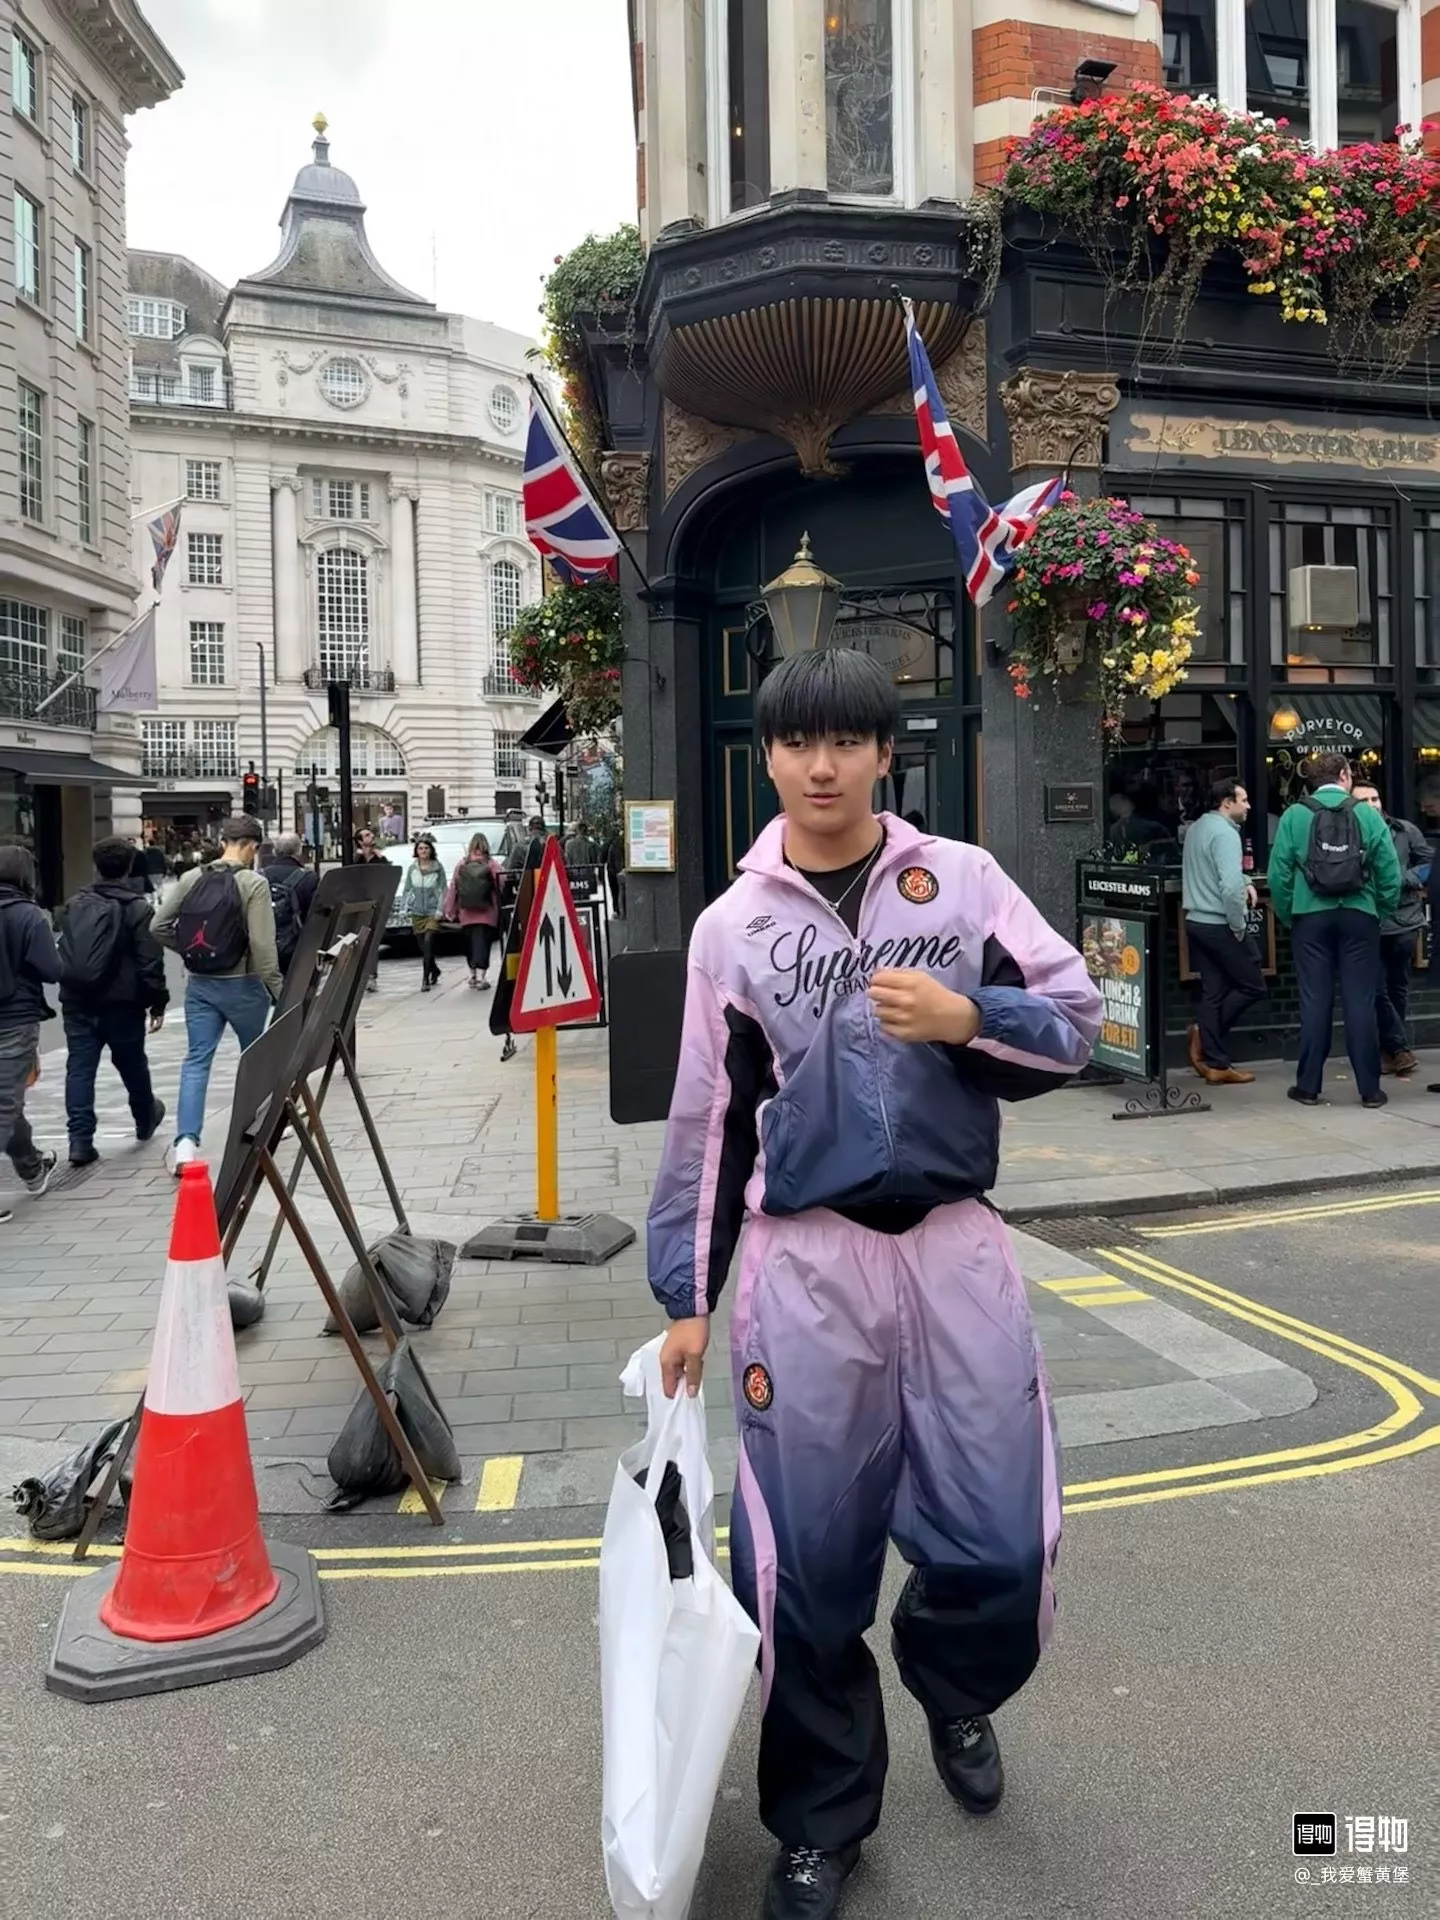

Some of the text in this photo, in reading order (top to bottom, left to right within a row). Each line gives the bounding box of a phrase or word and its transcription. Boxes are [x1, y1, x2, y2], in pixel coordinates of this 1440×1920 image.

[1217, 428, 1438, 461] LEICESTER ARMS
[1285, 718, 1364, 742] PURVEYOR
[1296, 744, 1354, 754] OF QUALITY
[1088, 880, 1151, 896] LEICESTER ARMS
[770, 924, 960, 1018] Supreme
[1100, 978, 1142, 1007] LUNCH &
[1109, 1004, 1140, 1028] DRINK
[1101, 1021, 1120, 1046] FOR
